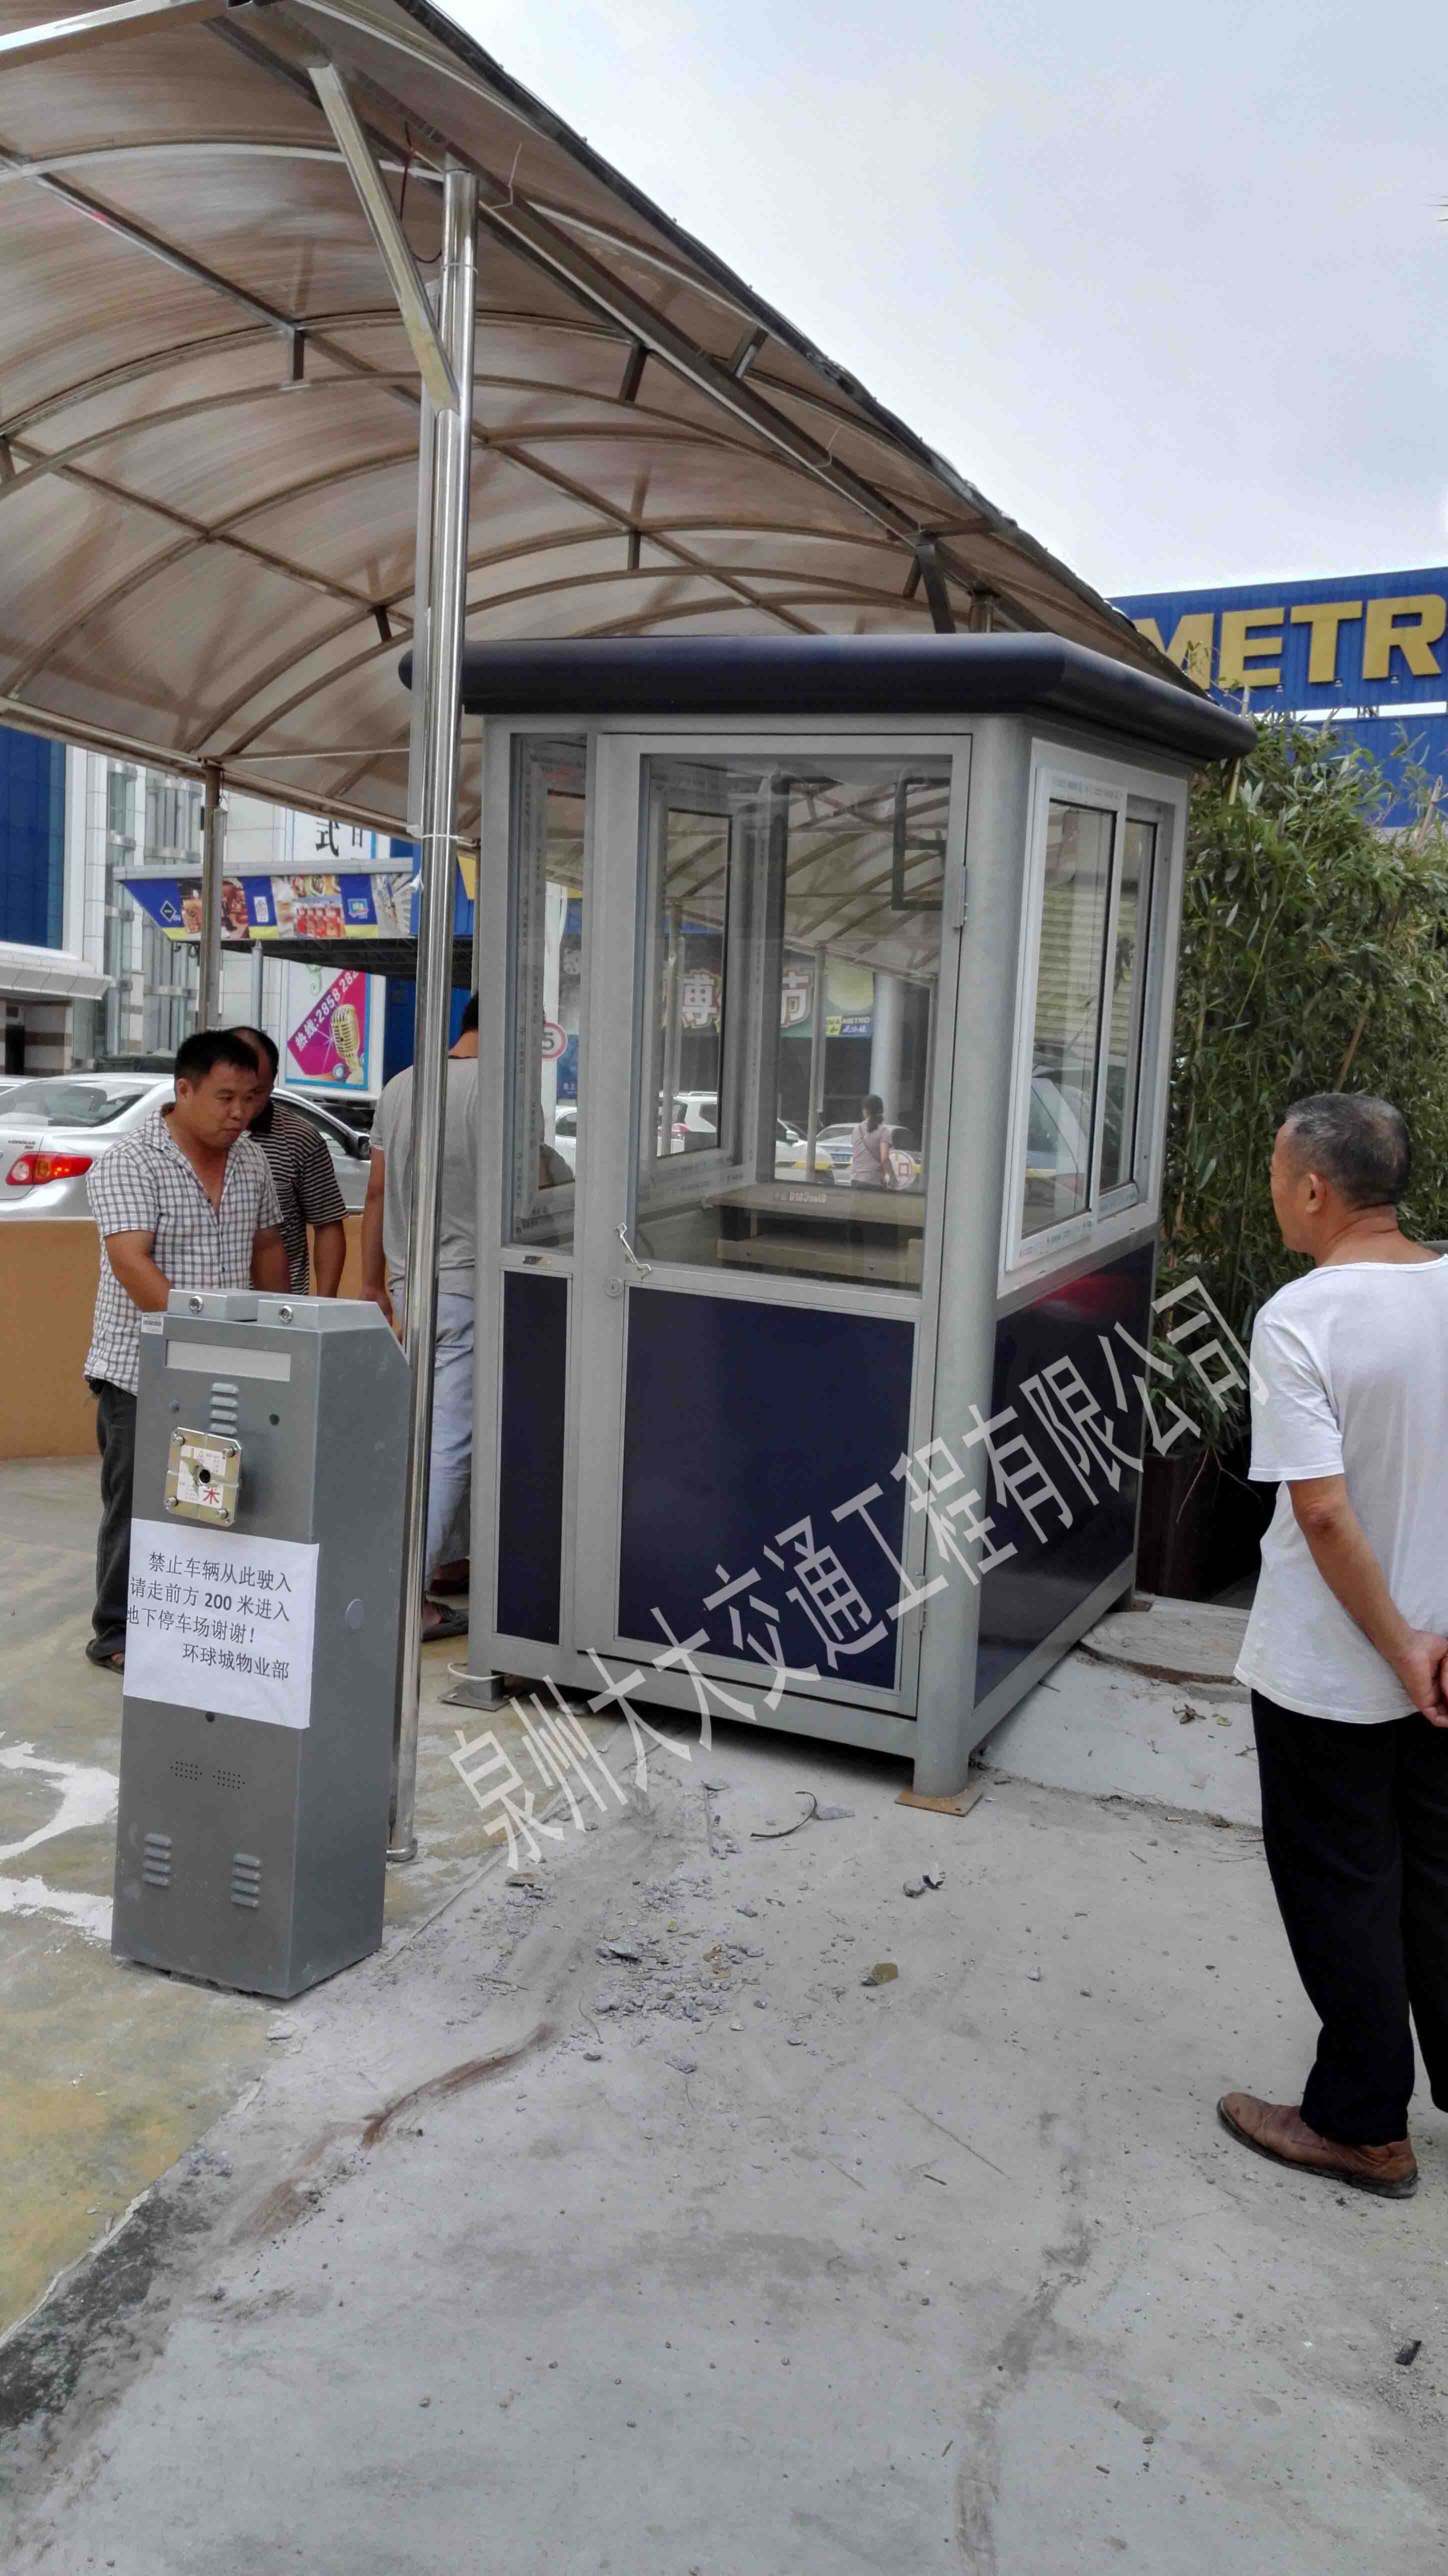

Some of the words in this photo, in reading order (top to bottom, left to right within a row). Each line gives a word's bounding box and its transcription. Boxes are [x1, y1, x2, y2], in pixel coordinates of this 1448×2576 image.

[1132, 594, 1446, 690] METR
[148, 1551, 292, 1592] 禁止车辆从此驶入
[130, 1576, 199, 1608] 请走前方
[204, 1592, 232, 1611] 200
[236, 1594, 290, 1622] 米进入
[126, 1604, 255, 1644] 地下停车场谢谢！
[182, 1643, 290, 1680] 环球城物业部
